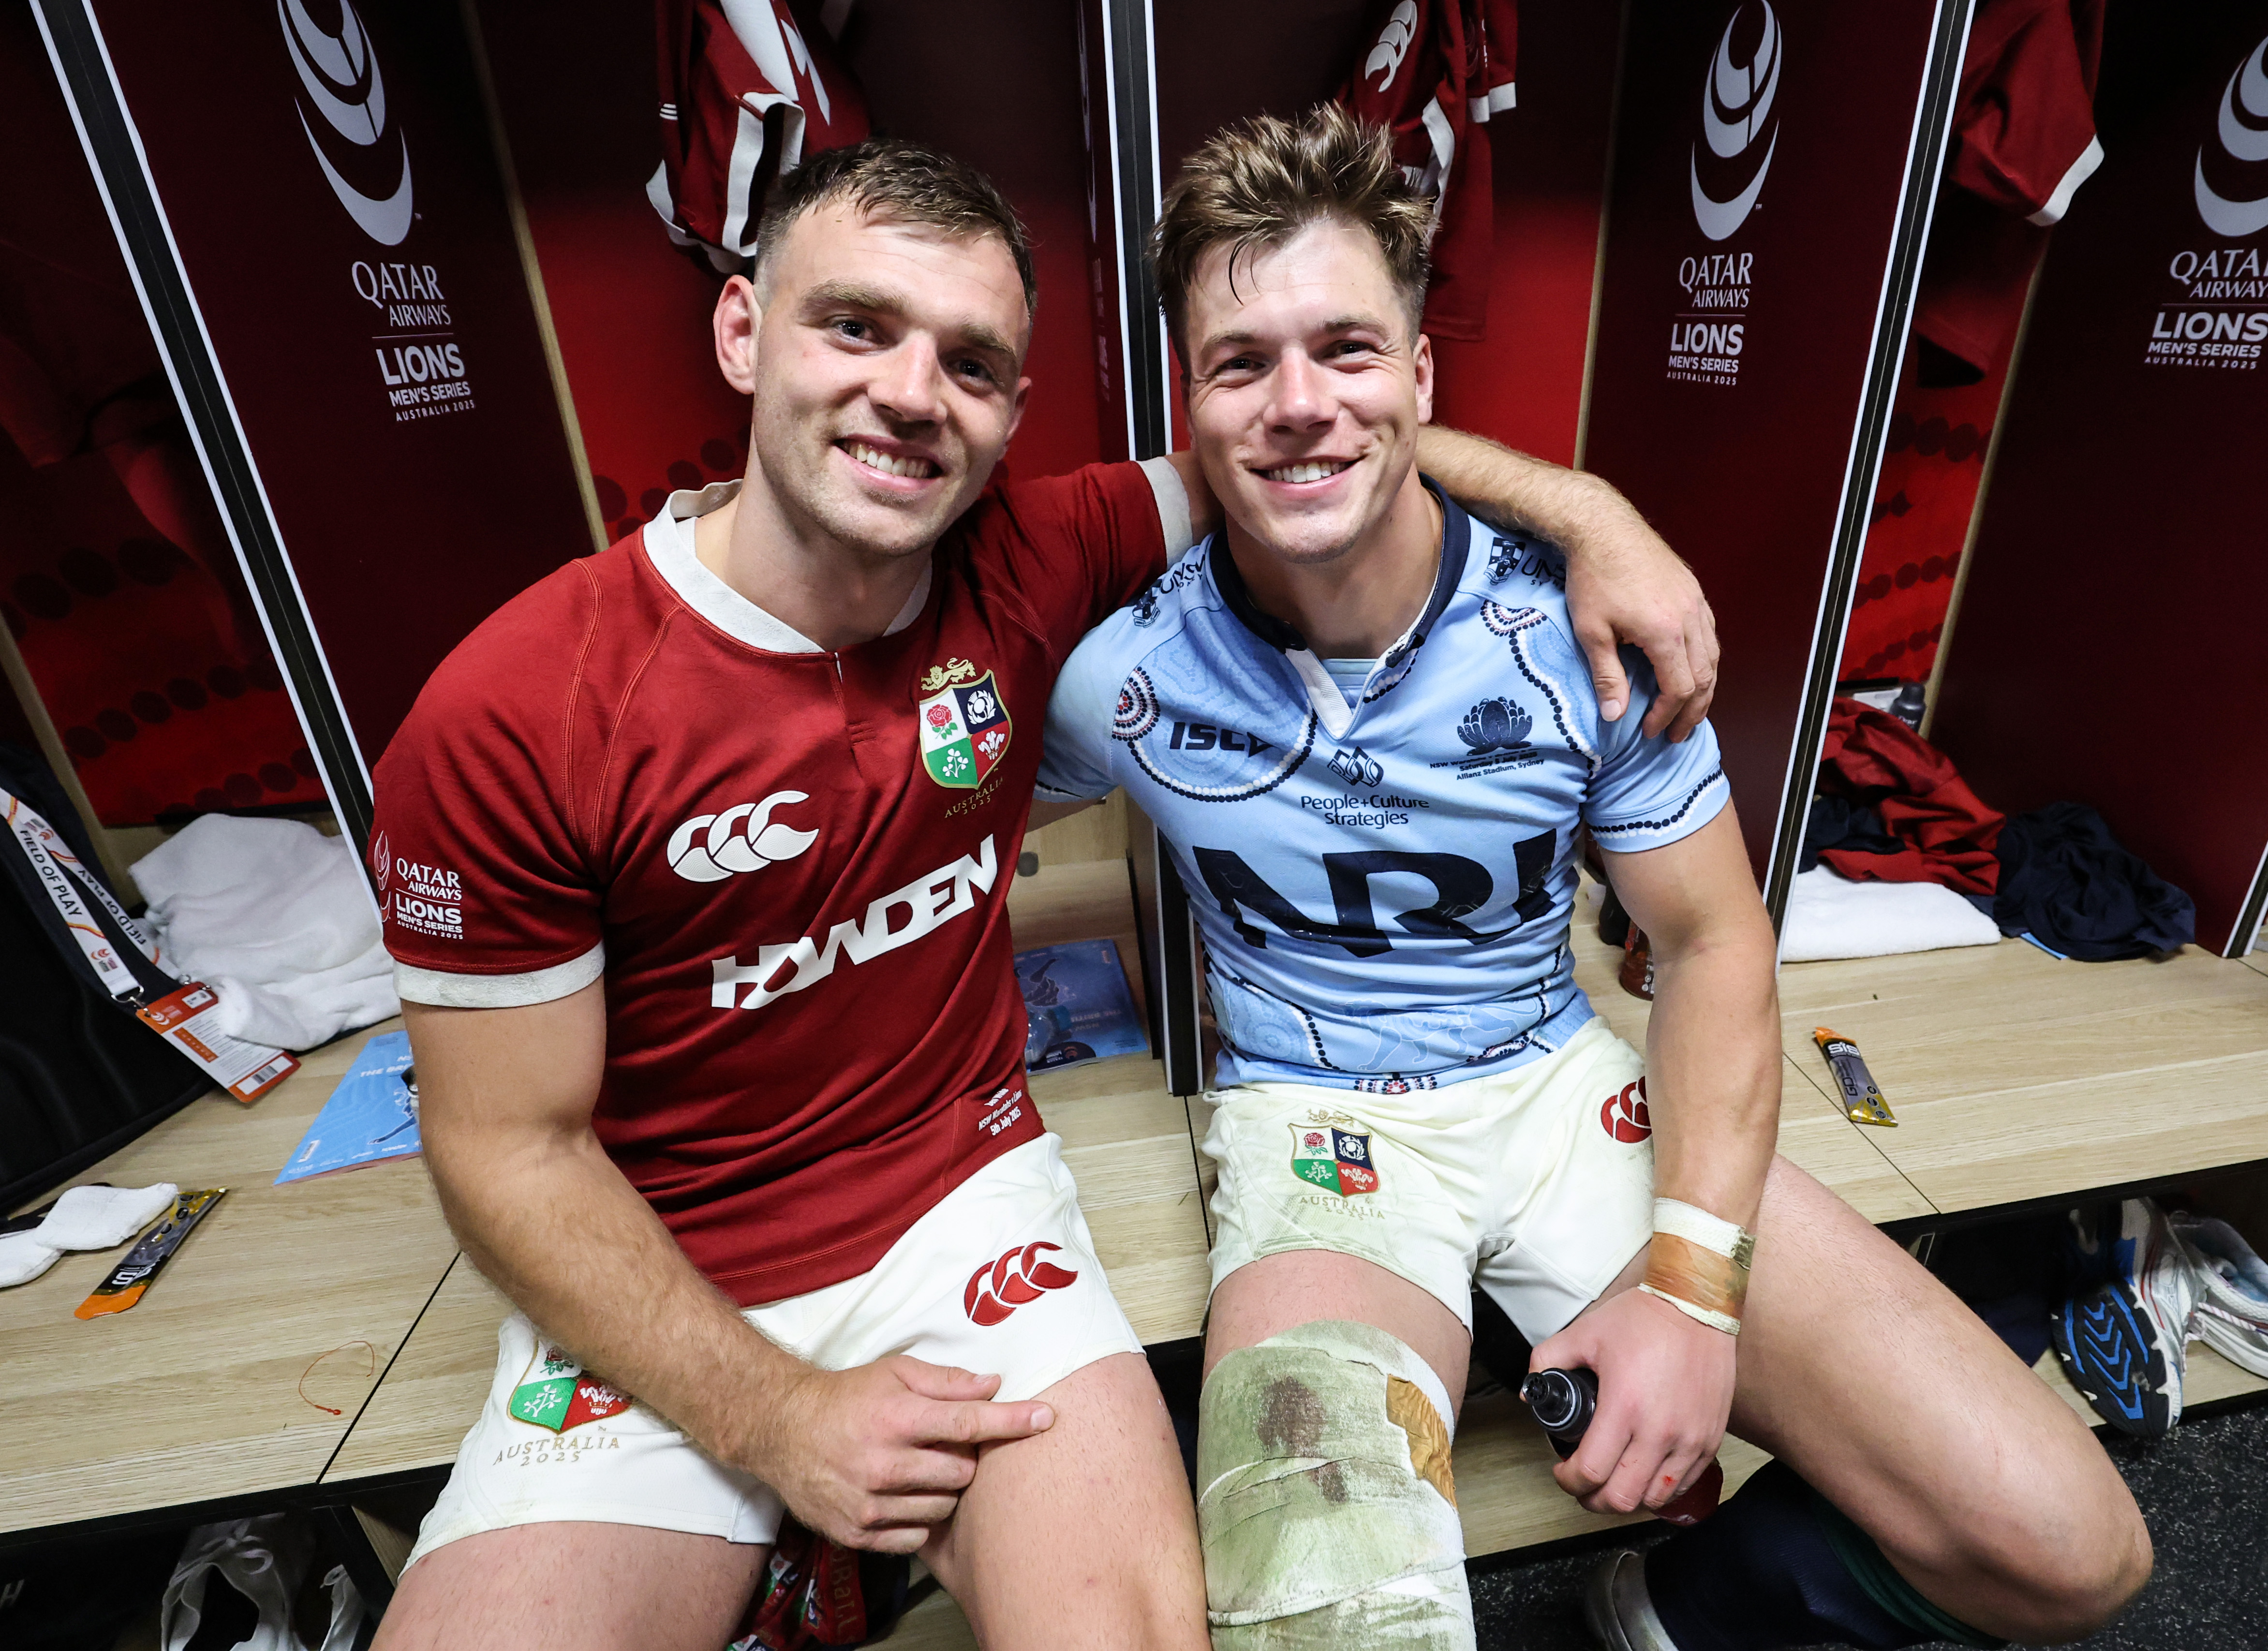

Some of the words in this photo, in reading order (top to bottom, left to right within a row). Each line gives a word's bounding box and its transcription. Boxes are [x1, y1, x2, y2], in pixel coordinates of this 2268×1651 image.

[1679, 252, 1753, 293] QATAR
[352, 261, 445, 309] QATAR
[2189, 280, 2268, 298] AIRWAY
[1692, 288, 1749, 308] AIRWAYS
[389, 305, 451, 327] AIRWAYS
[2152, 312, 2268, 342] LIONS
[1670, 323, 1744, 355] LIONS
[2148, 341, 2198, 354] MEN'S
[2200, 343, 2262, 358] SERIES
[376, 343, 466, 385] LIONS
[1668, 355, 1699, 370] MEN'S
[1701, 357, 1739, 373] SERIES
[2145, 356, 2216, 367] AUSTRALIA
[2221, 360, 2257, 369] 2025
[1667, 371, 1711, 383] AUSTRALIA
[1715, 375, 1737, 385] 2025
[389, 386, 430, 407] MEN'S
[431, 381, 472, 400] SERIES
[396, 404, 450, 422] AUSTRALIA
[453, 399, 475, 412] 2025
[1456, 771, 1482, 780] Allianz
[1483, 765, 1516, 775] Stadium,
[1517, 759, 1544, 768] Sydney
[945, 776, 1004, 818] AUSTRALIA
[964, 795, 991, 815] 2025
[1301, 794, 1429, 812] People+Culture
[1324, 811, 1408, 829] Strategies
[20, 830, 45, 864] FIELD
[42, 866, 61, 882] OF
[53, 885, 82, 915] PLAY
[397, 858, 461, 888] QATAR
[408, 881, 462, 900] AIRWAYS
[396, 893, 462, 924] LIONS
[397, 911, 422, 927] MEN'S
[424, 921, 463, 933] SERIES
[397, 920, 437, 936] AUSTRALIA
[978, 1114, 992, 1131] NSW
[992, 1099, 1011, 1120] Waratahs
[990, 1123, 1001, 1136] 5th
[999, 1116, 1012, 1130] July
[1009, 1106, 1022, 1122] 2025
[1299, 1196, 1385, 1220] AUSTRALIA
[1325, 1207, 1364, 1221] 2025
[493, 1436, 620, 1466] AUSTRALIA
[520, 1451, 581, 1466] 2025
